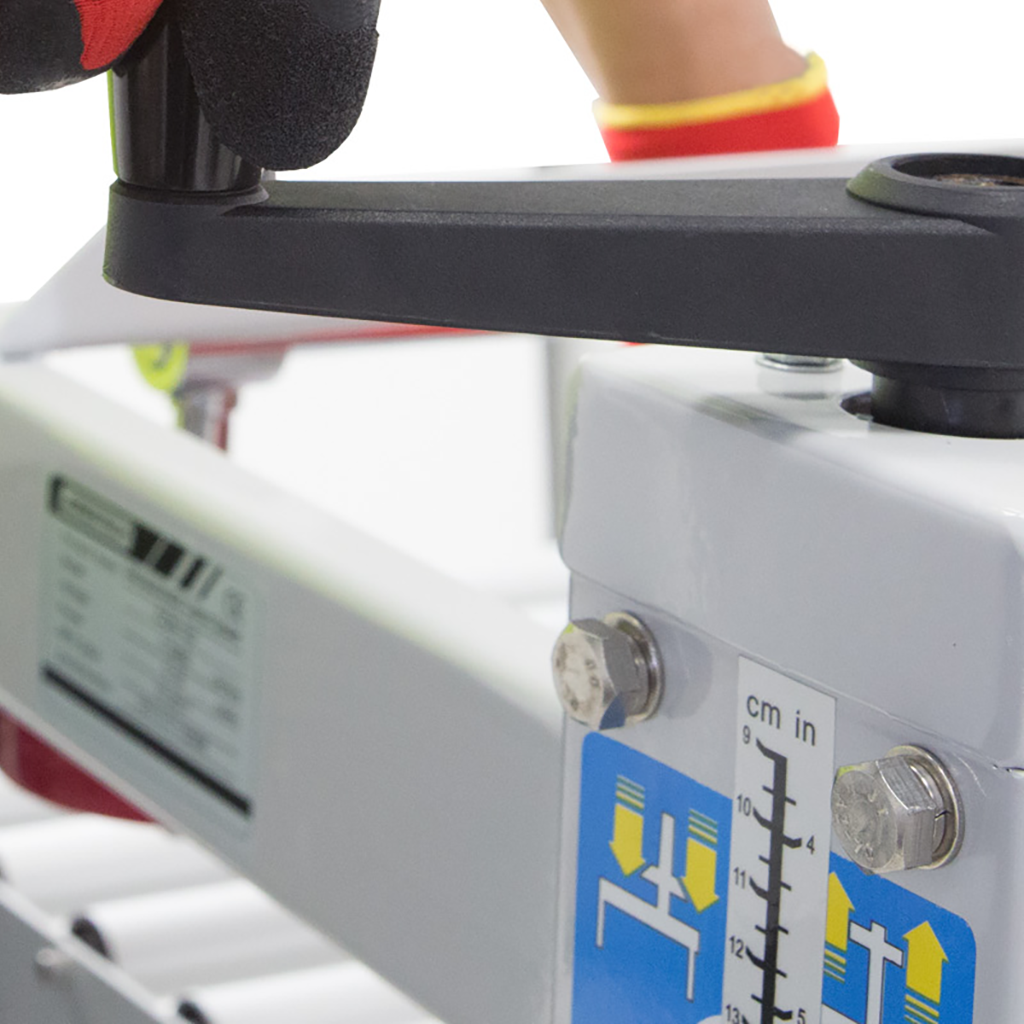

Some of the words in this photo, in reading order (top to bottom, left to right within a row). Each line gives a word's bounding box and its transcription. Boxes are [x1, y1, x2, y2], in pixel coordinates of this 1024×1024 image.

[746, 694, 781, 730] cm
[794, 709, 816, 747] in
[742, 724, 751, 745] 9
[736, 793, 752, 817] 10
[806, 834, 815, 855] 4
[733, 866, 746, 890] 11
[729, 935, 745, 960] 12
[725, 1003, 741, 1024] 13
[797, 1007, 806, 1024] 5
